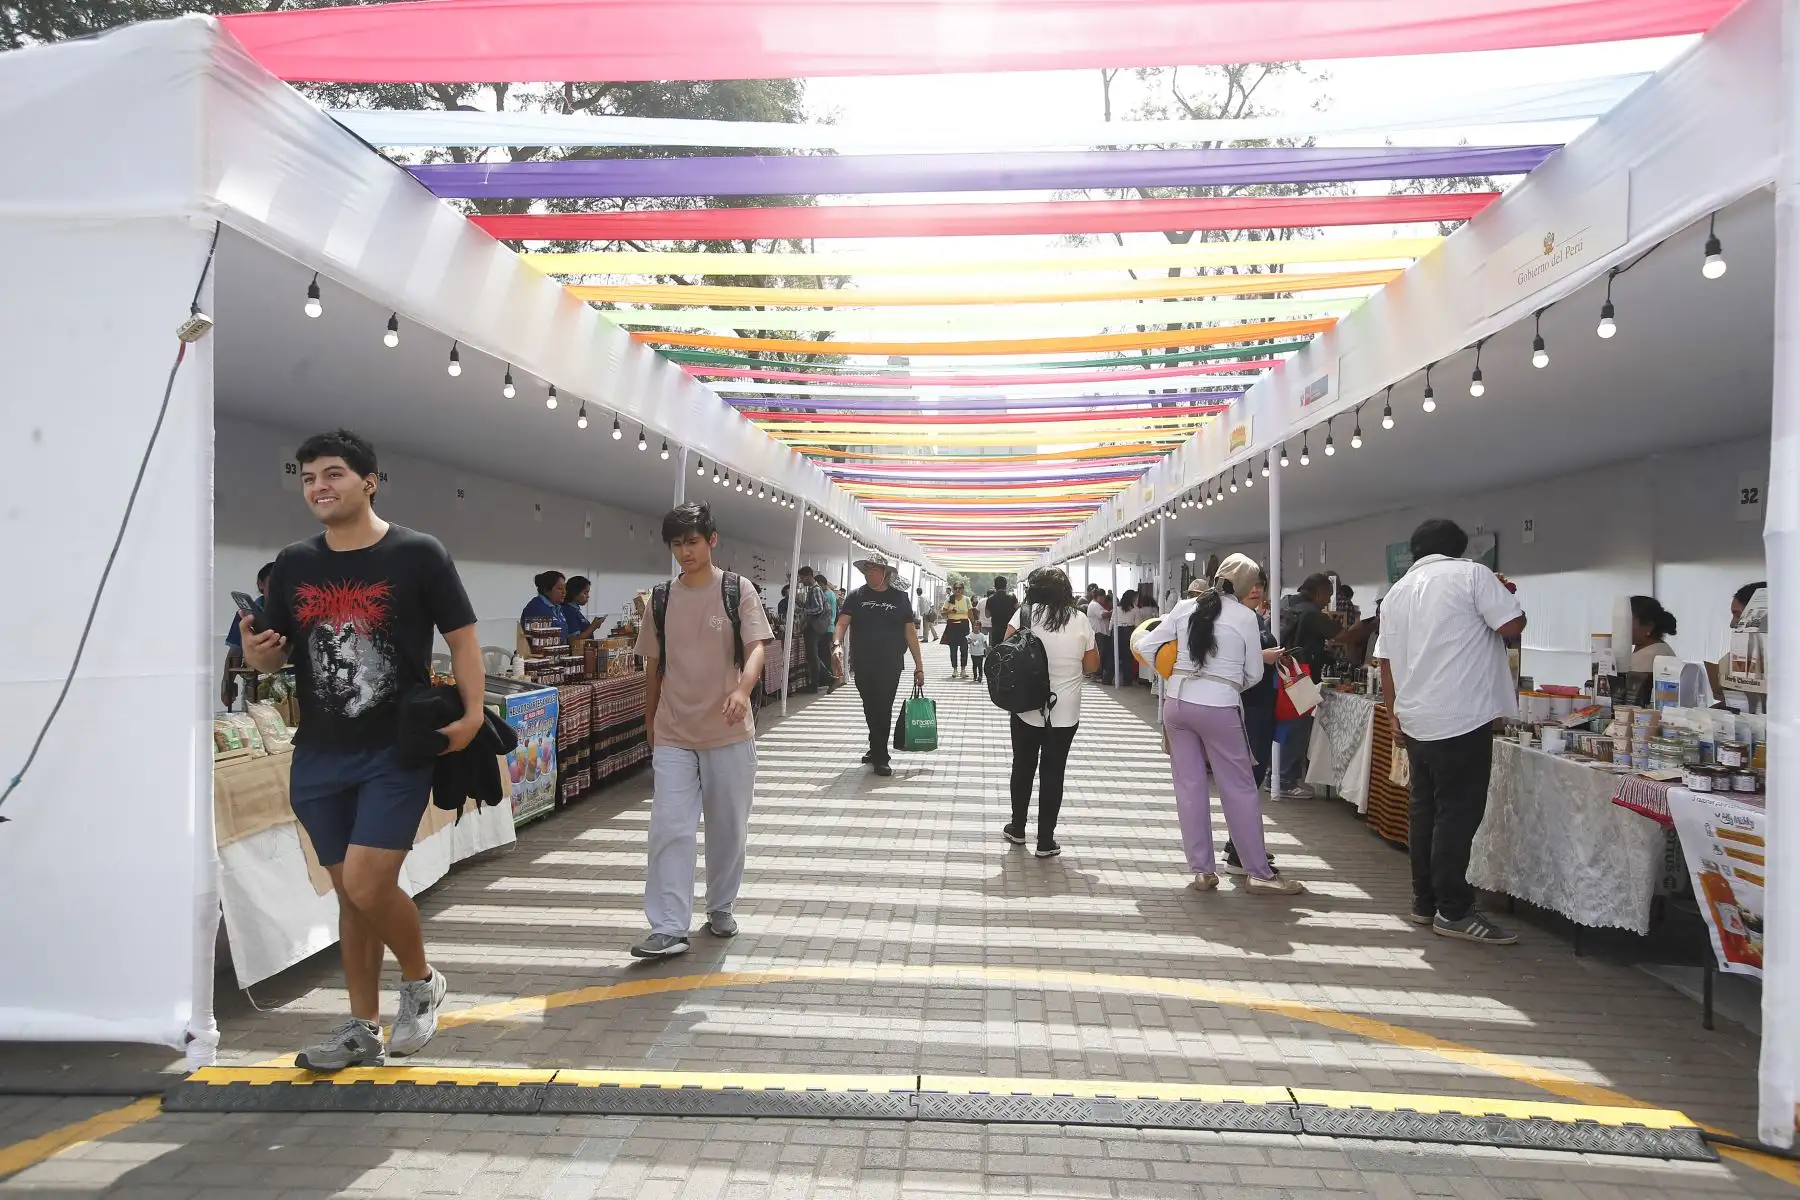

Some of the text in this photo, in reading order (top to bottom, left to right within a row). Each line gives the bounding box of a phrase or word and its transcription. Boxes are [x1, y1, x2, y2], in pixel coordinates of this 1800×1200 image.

[1517, 238, 1583, 285] Gobierno del Perú
[285, 463, 297, 475] 93
[379, 472, 388, 482] 94
[1740, 487, 1759, 504] 32
[1524, 519, 1533, 531] 33
